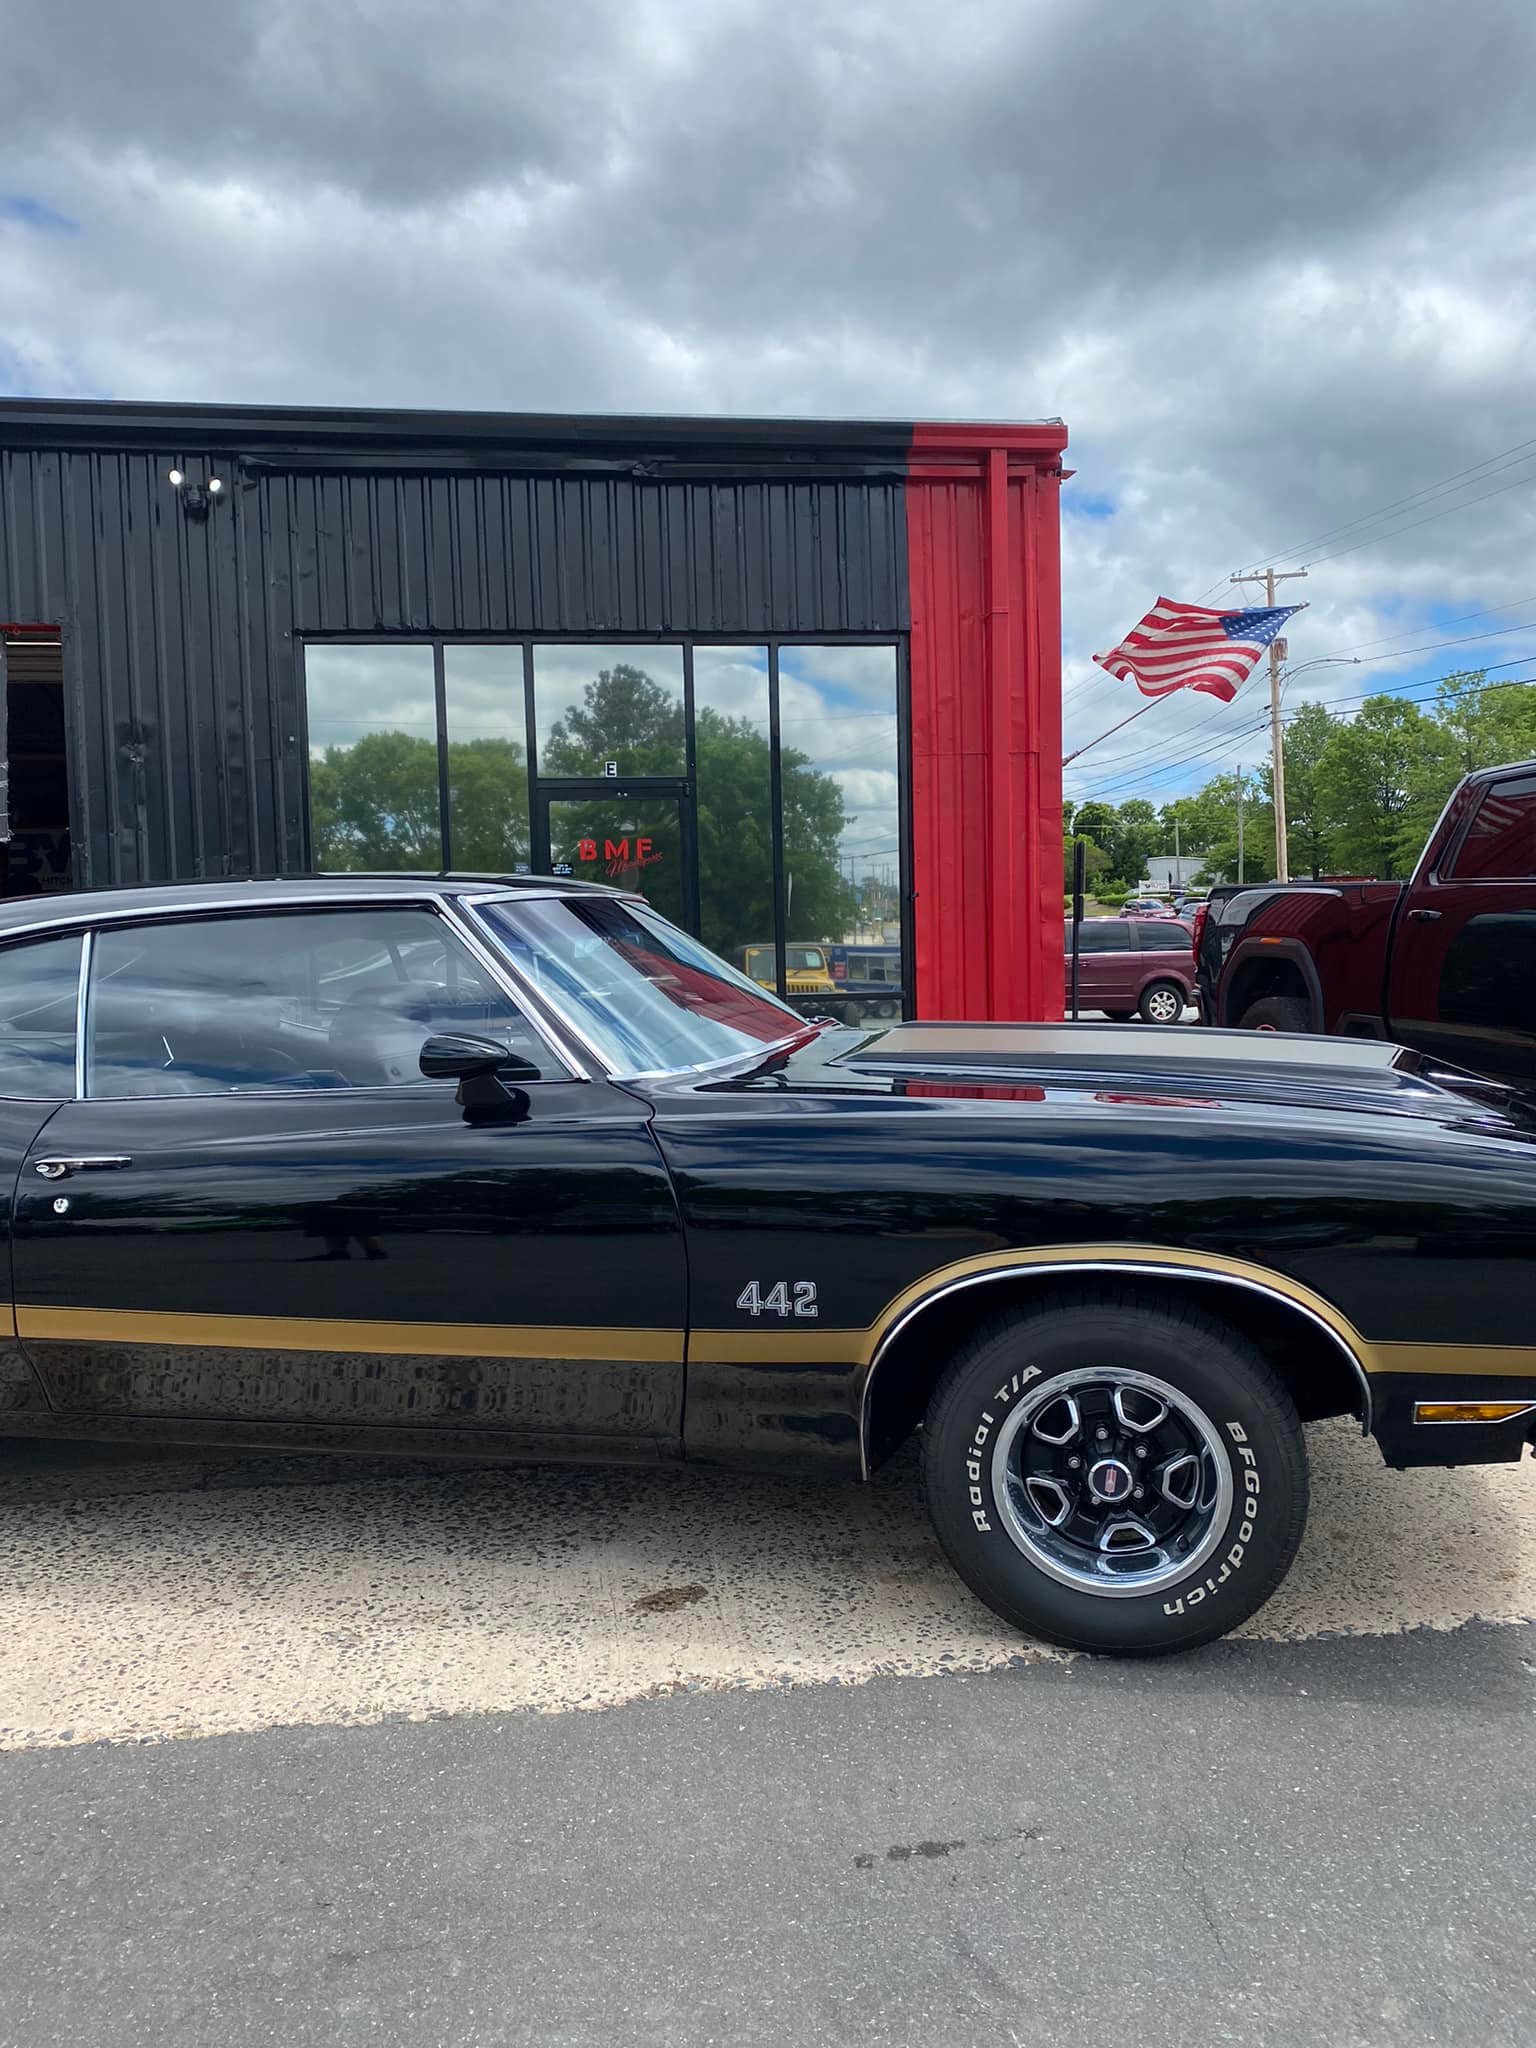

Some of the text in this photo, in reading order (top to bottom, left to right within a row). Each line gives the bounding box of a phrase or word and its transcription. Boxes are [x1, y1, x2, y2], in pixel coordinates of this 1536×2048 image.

[606, 763, 616, 776] E
[579, 838, 653, 861] BMF
[736, 1280, 818, 1317] 442
[966, 1364, 1043, 1533] Radial T/A
[1162, 1420, 1261, 1617] BFGoodrich
